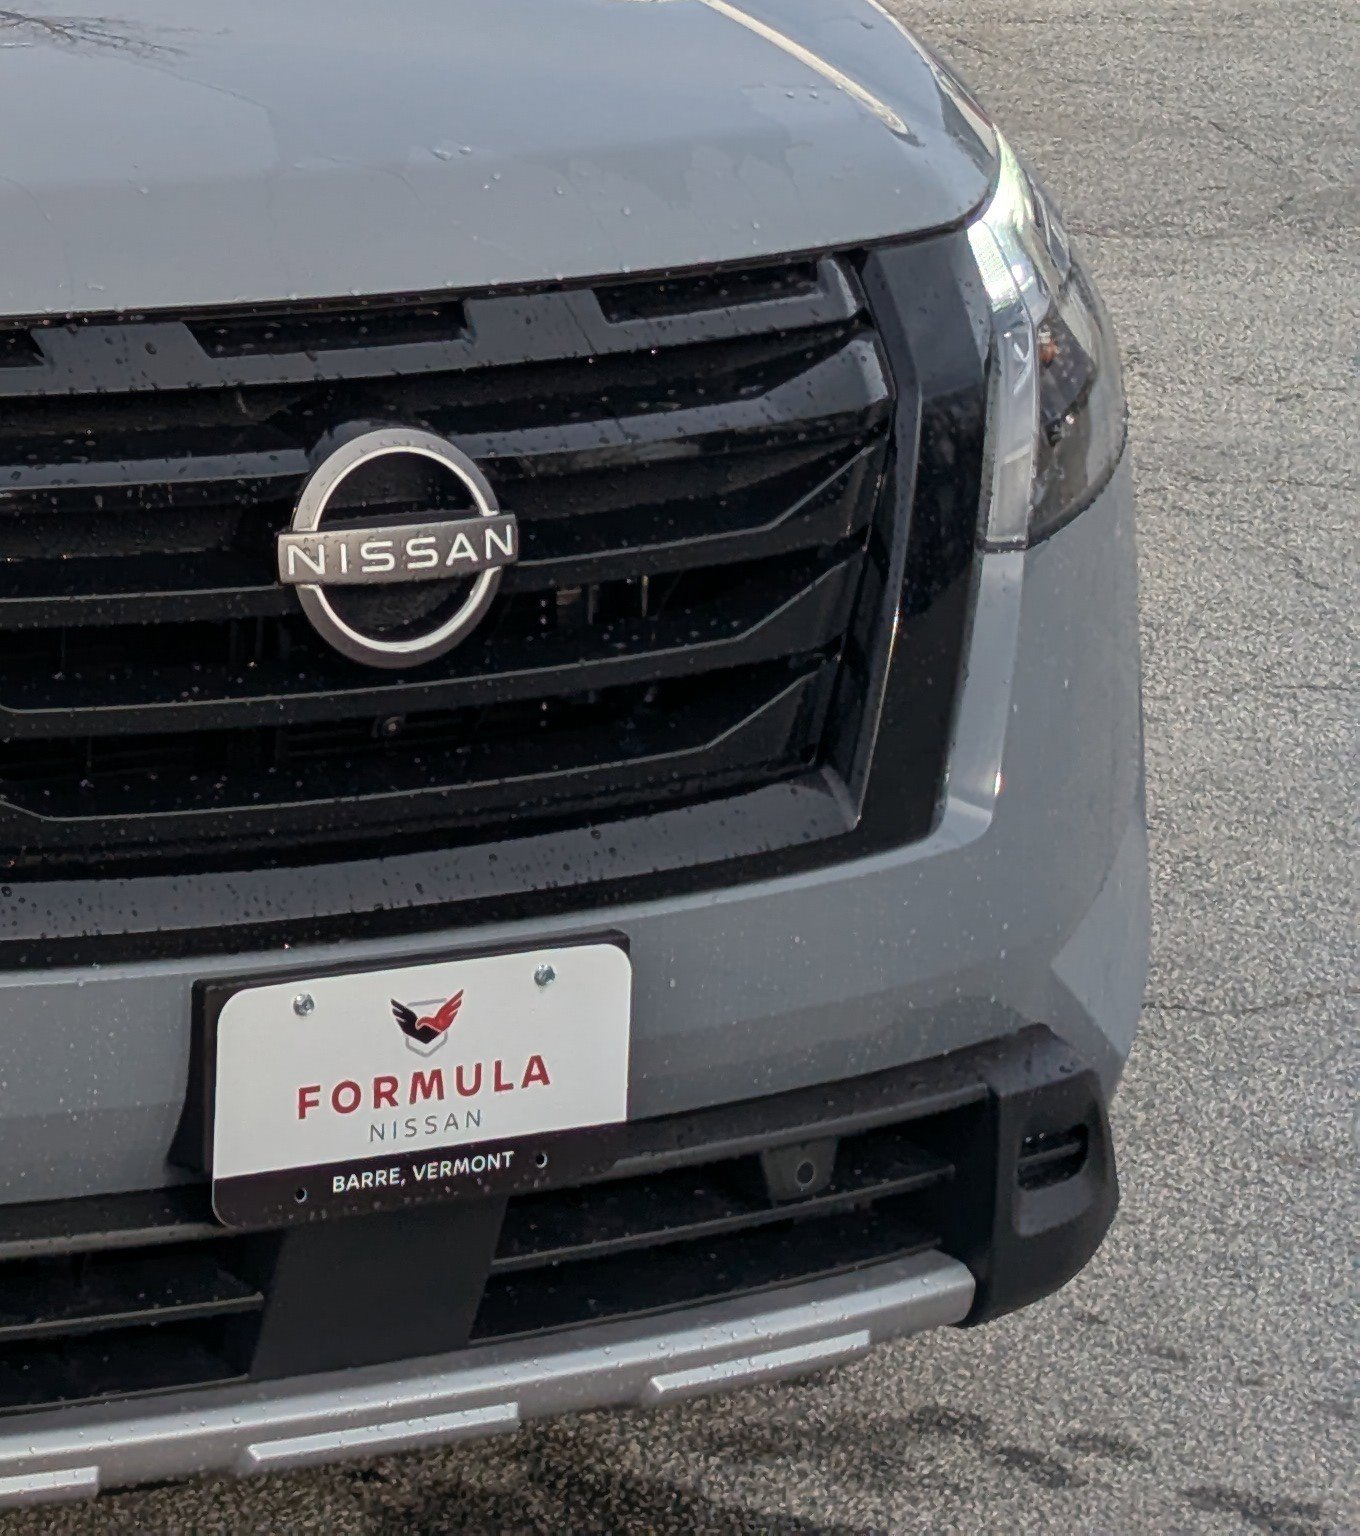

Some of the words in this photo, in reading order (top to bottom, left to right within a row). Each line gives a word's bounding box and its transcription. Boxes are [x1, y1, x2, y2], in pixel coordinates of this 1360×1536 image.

[287, 524, 514, 577] NISSAN
[298, 1054, 551, 1121] FORMULA
[369, 1108, 482, 1143] NISSAN
[333, 1167, 406, 1194] BARRE,
[412, 1150, 515, 1182] VERMONT
